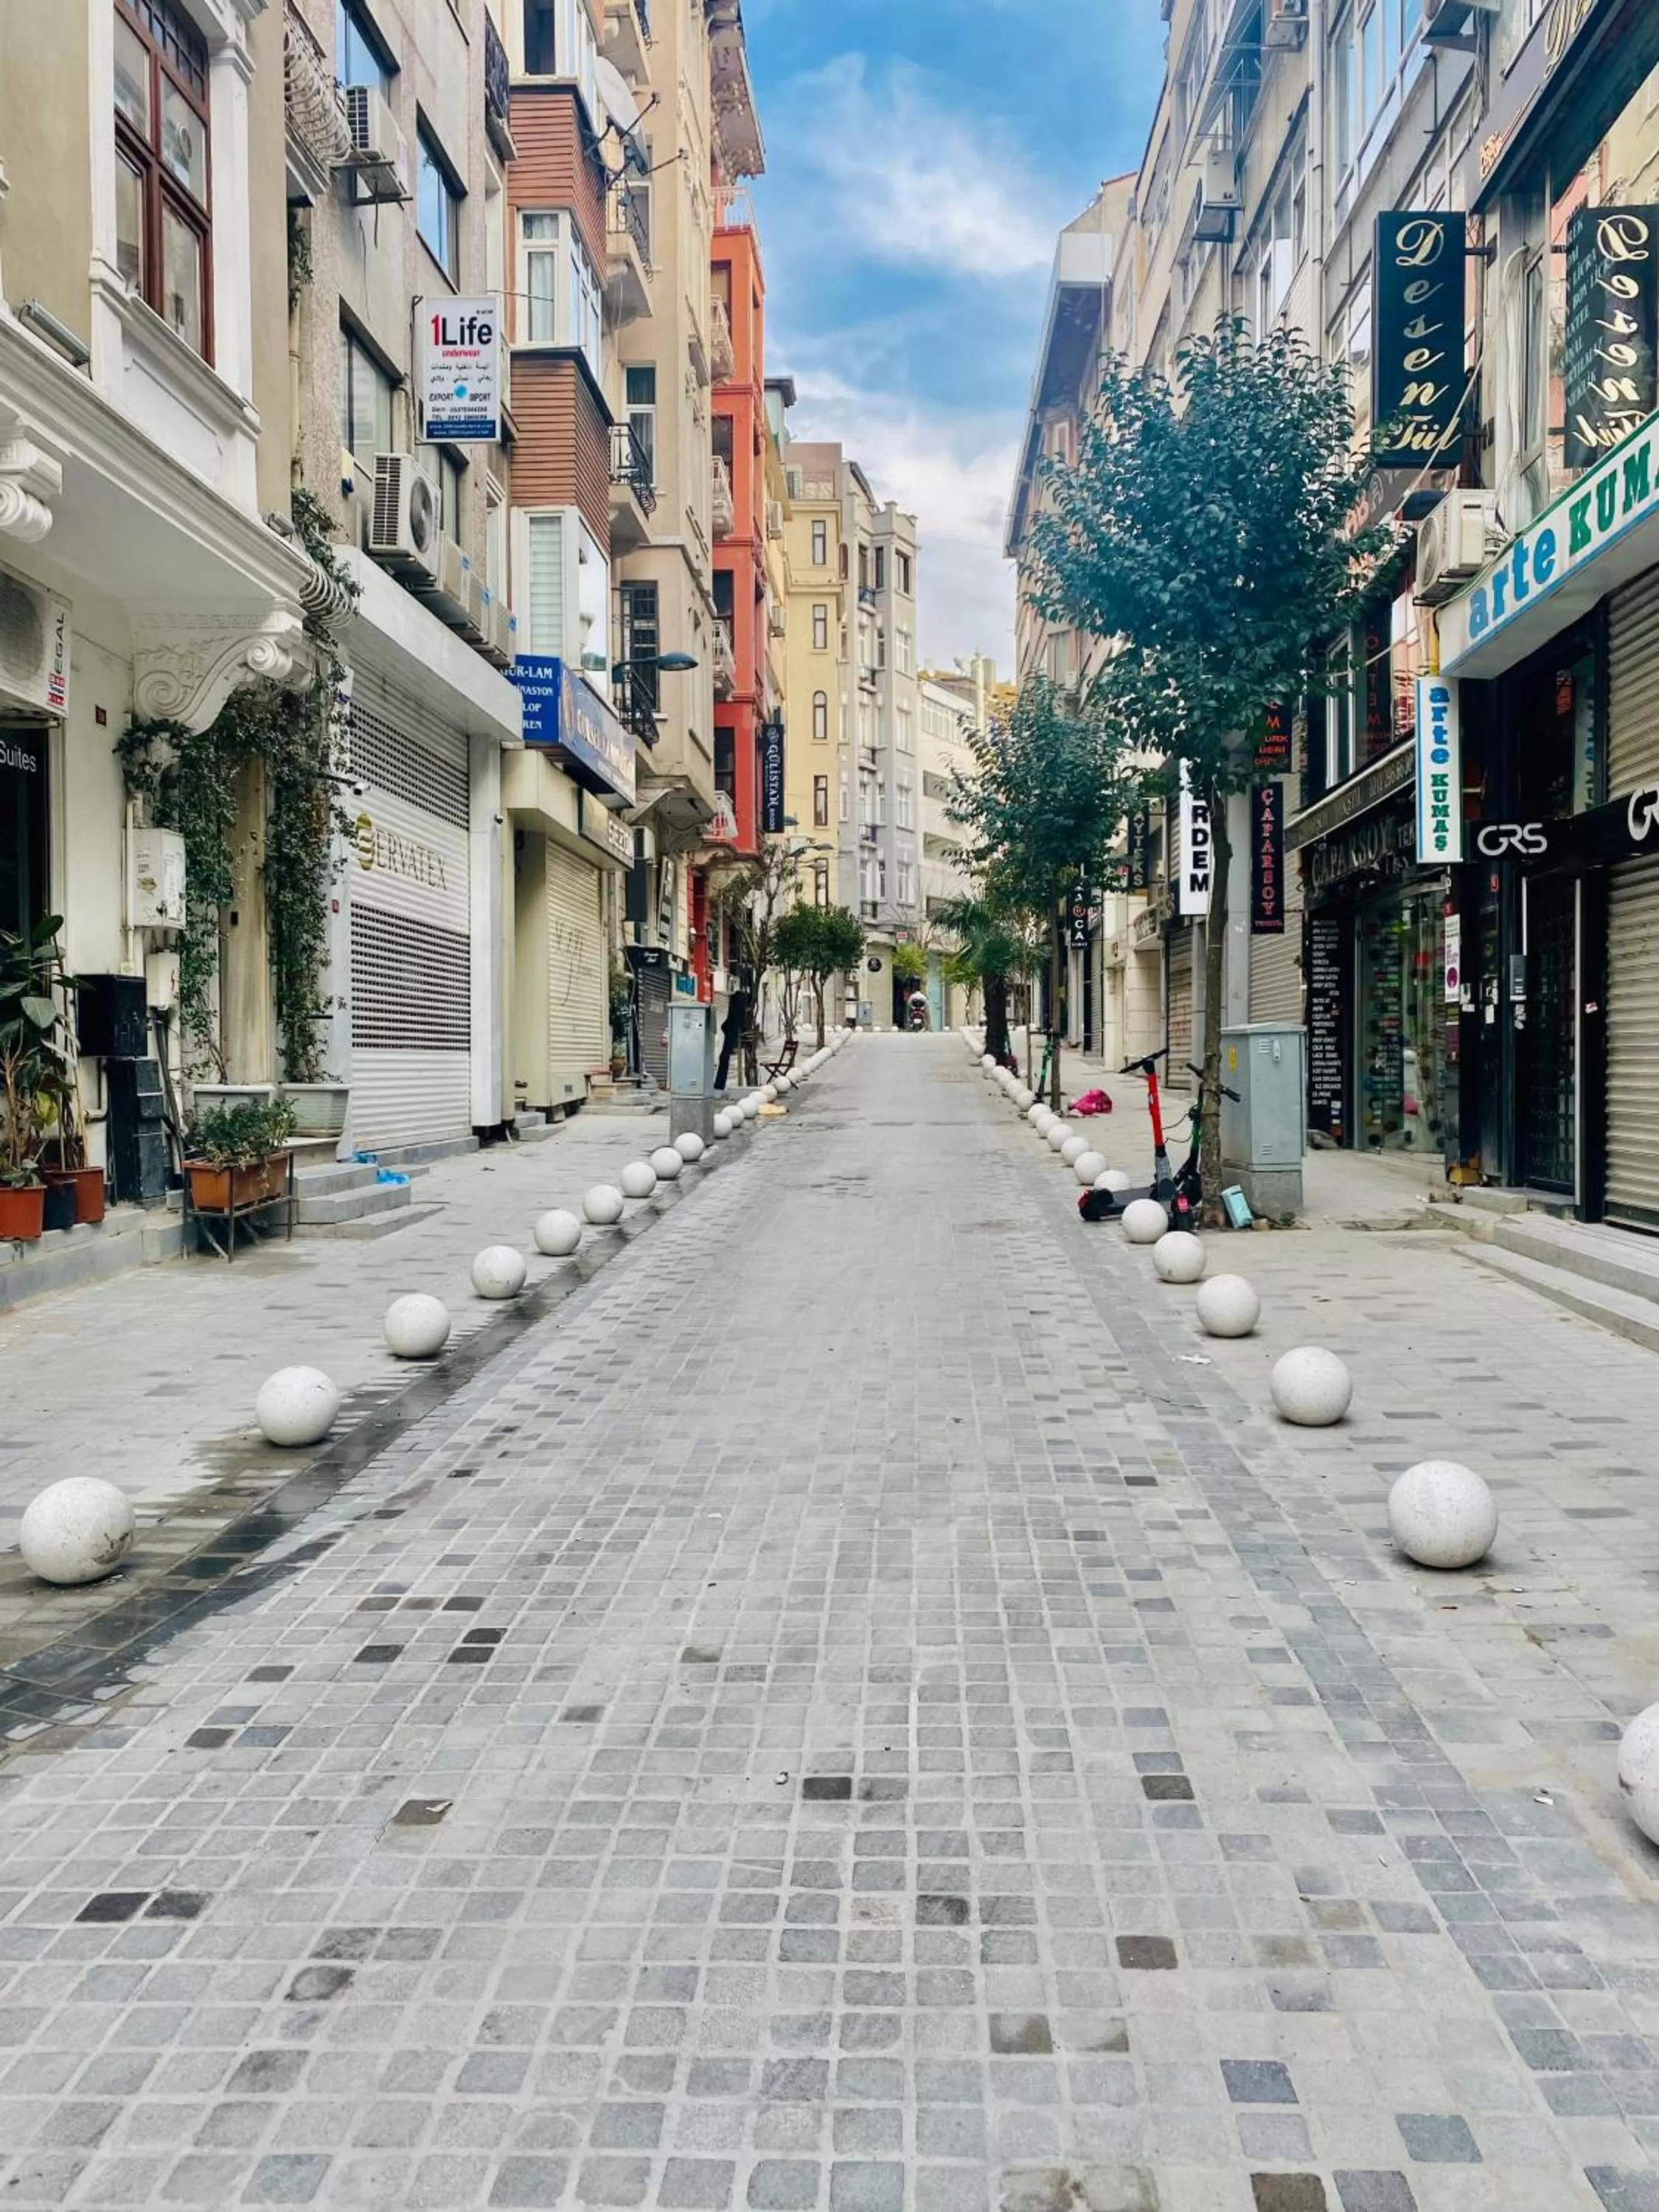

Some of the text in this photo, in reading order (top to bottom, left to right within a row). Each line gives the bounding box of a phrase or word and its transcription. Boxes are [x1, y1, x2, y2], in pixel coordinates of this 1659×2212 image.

[431, 314, 493, 346] 1Life
[1396, 219, 1450, 407] Desen
[1469, 439, 1659, 639] arte KUM
[1429, 686, 1450, 765] arte
[1261, 789, 1275, 915] ÇAPARSOY
[1430, 773, 1450, 852] KUMAŞ
[1477, 823, 1548, 856] GRS
